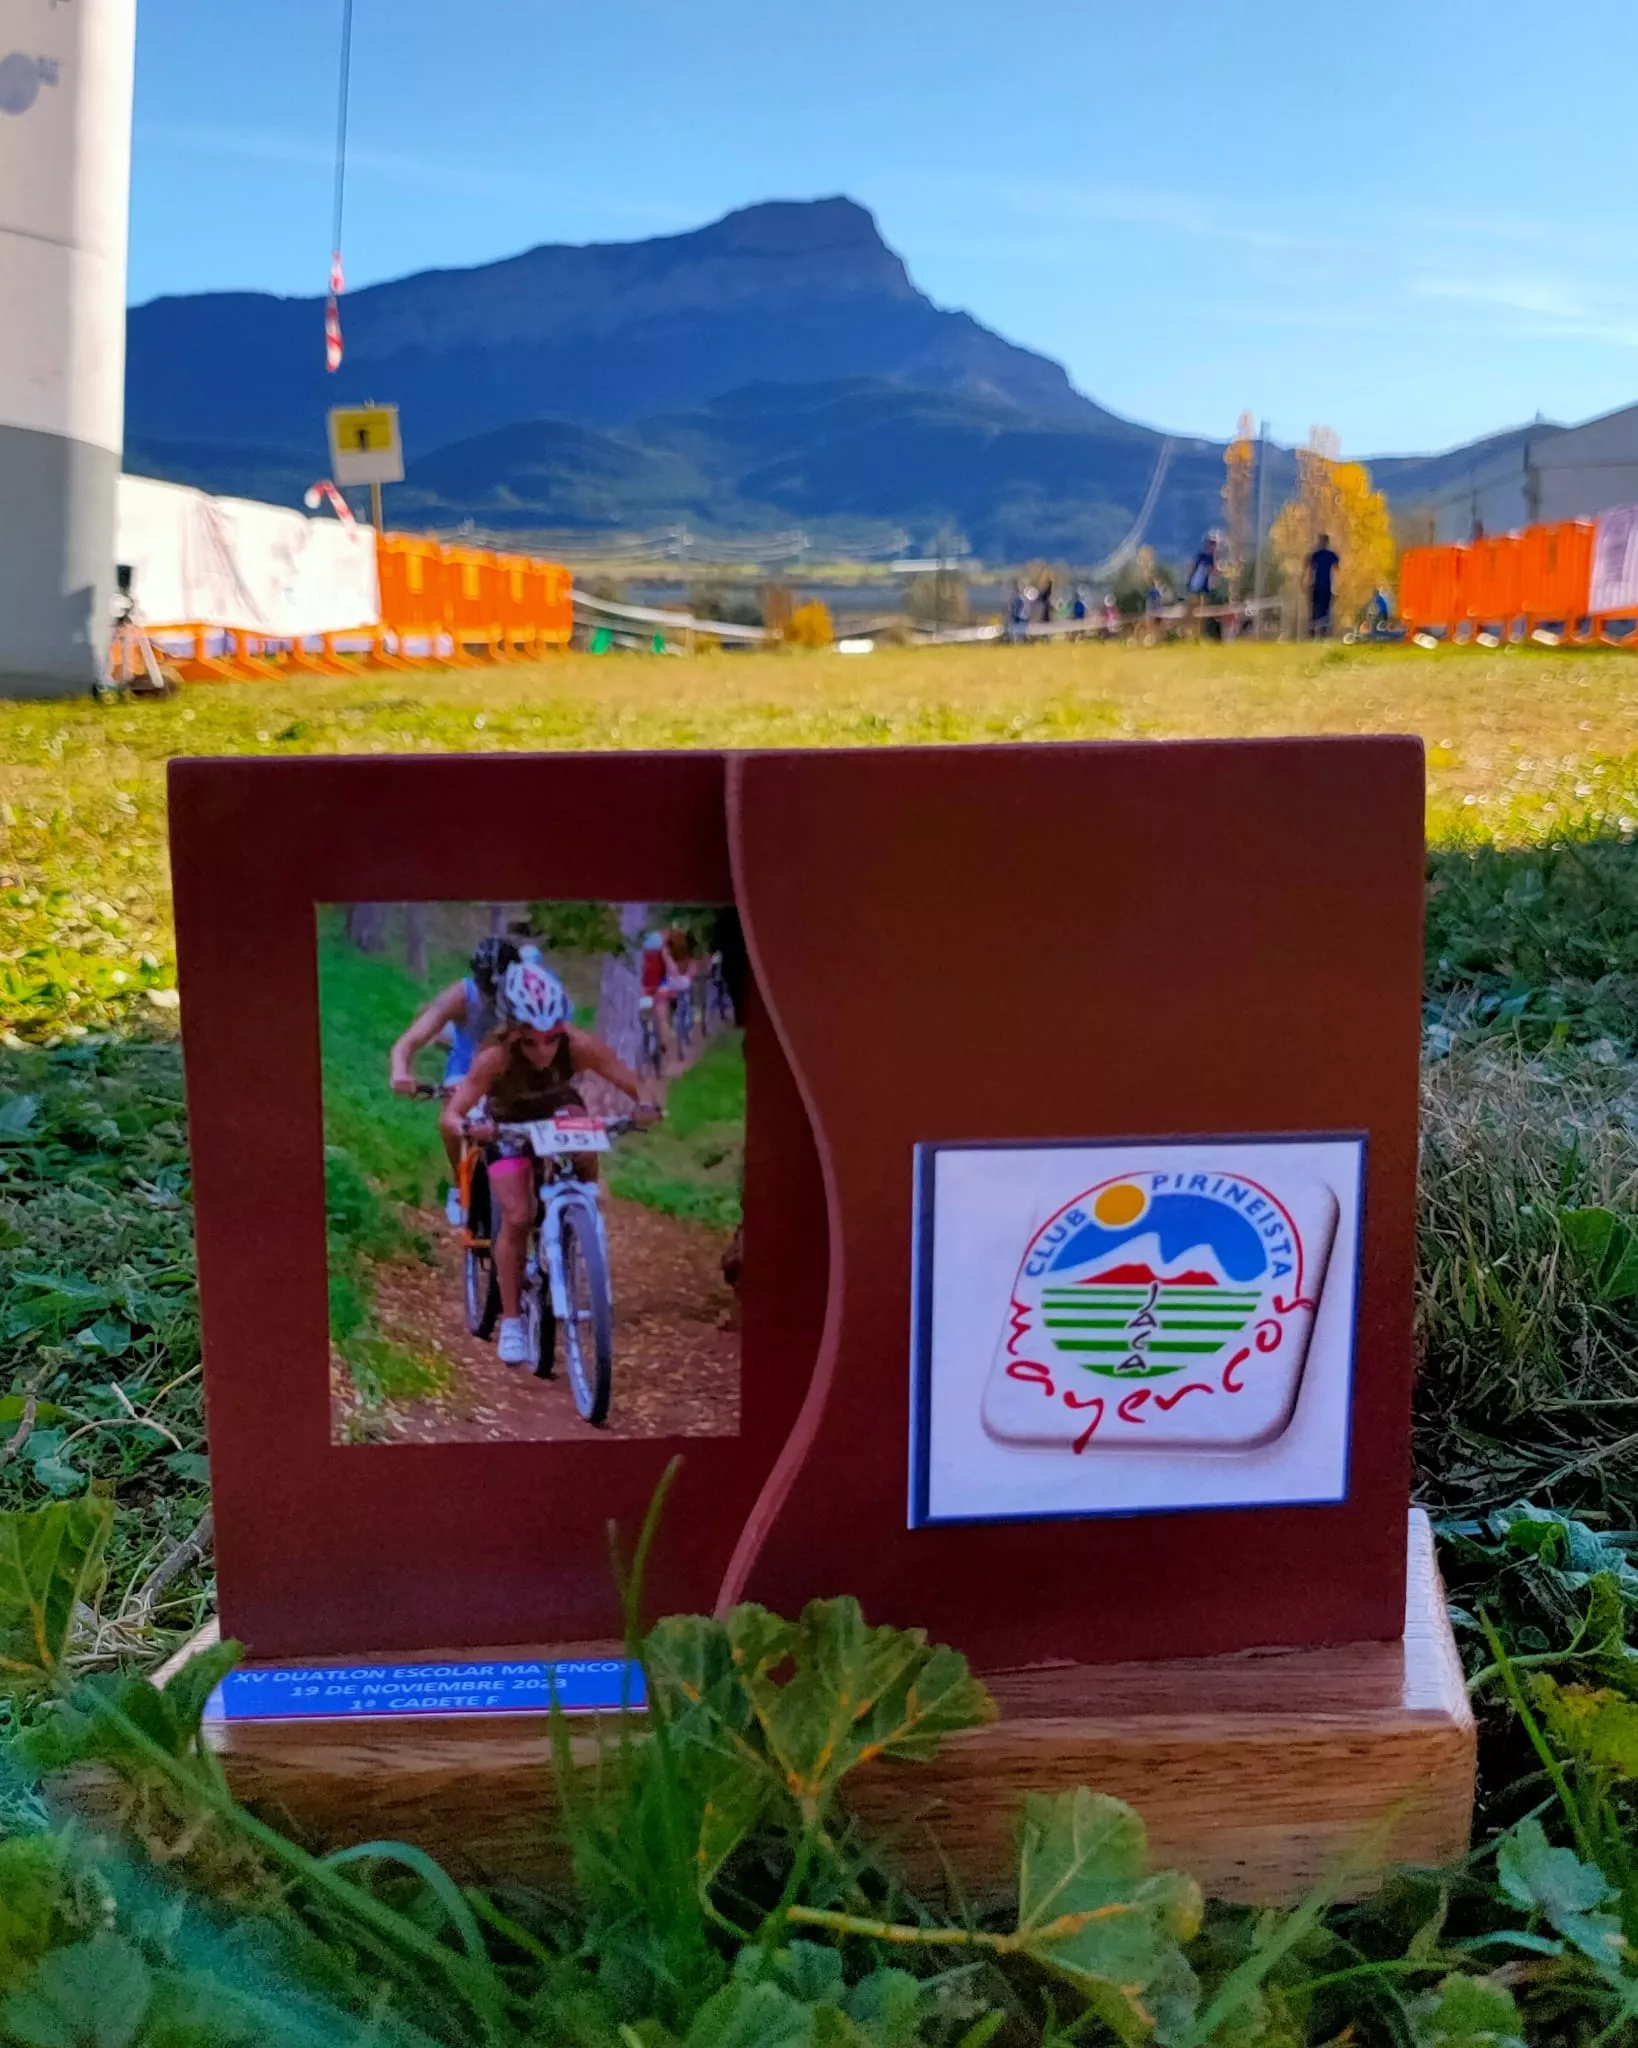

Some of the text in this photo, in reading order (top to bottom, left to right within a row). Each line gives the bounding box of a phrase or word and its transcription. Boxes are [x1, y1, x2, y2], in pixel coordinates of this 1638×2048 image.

[1025, 1173, 1293, 1279] CLUB PIRINEISTA
[1116, 1282, 1158, 1371] JACA
[234, 1672, 268, 1683] XV
[272, 1669, 386, 1682] DUATLON
[392, 1666, 494, 1678] ESCOLAR
[290, 1679, 567, 1696] 19 DE NOVIEMBRE 2023
[388, 1696, 480, 1708] CADETE
[486, 1695, 500, 1706] F
